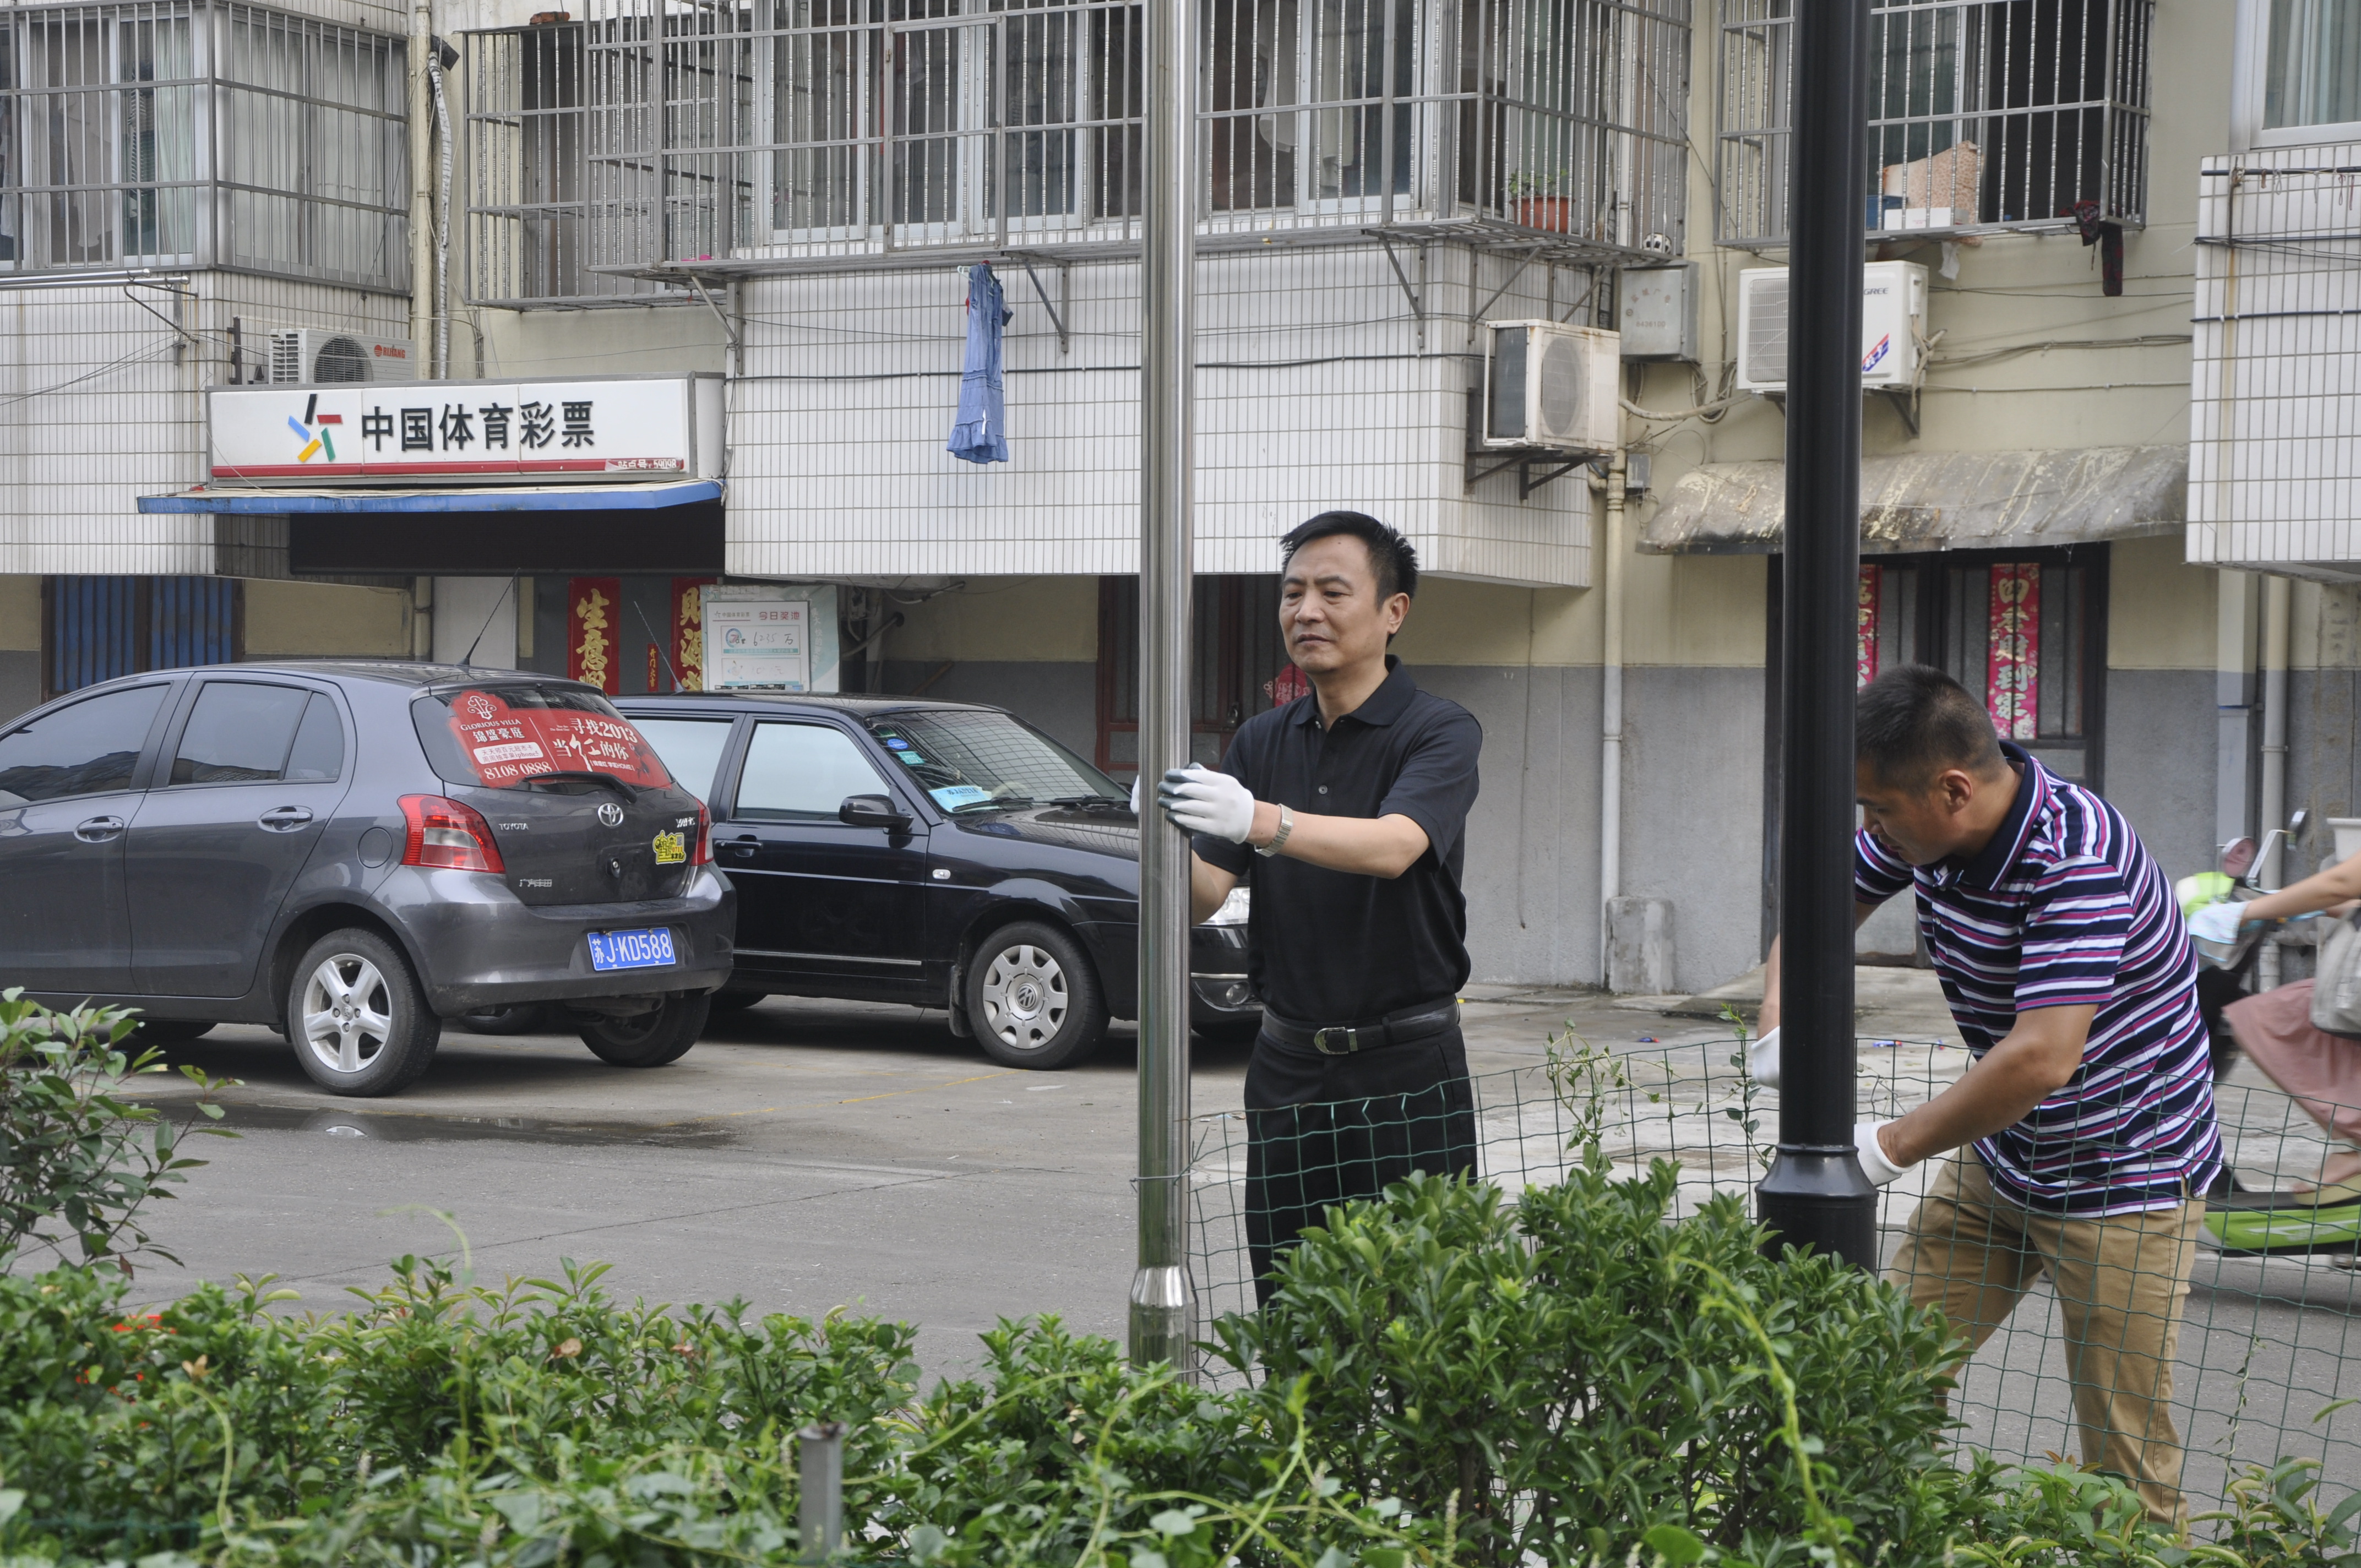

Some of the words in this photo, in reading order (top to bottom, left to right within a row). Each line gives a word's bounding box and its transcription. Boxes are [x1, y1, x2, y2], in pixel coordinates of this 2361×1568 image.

[362, 401, 594, 451] 中国体育彩票
[759, 611, 800, 620] 今日奖池
[460, 720, 501, 731] GLORIOUS
[569, 718, 638, 743] 寻找2013
[472, 727, 525, 743] 锦盛豪庭
[485, 764, 519, 780] 8108
[519, 761, 552, 775] 0888
[519, 879, 552, 888] 广汽丰田
